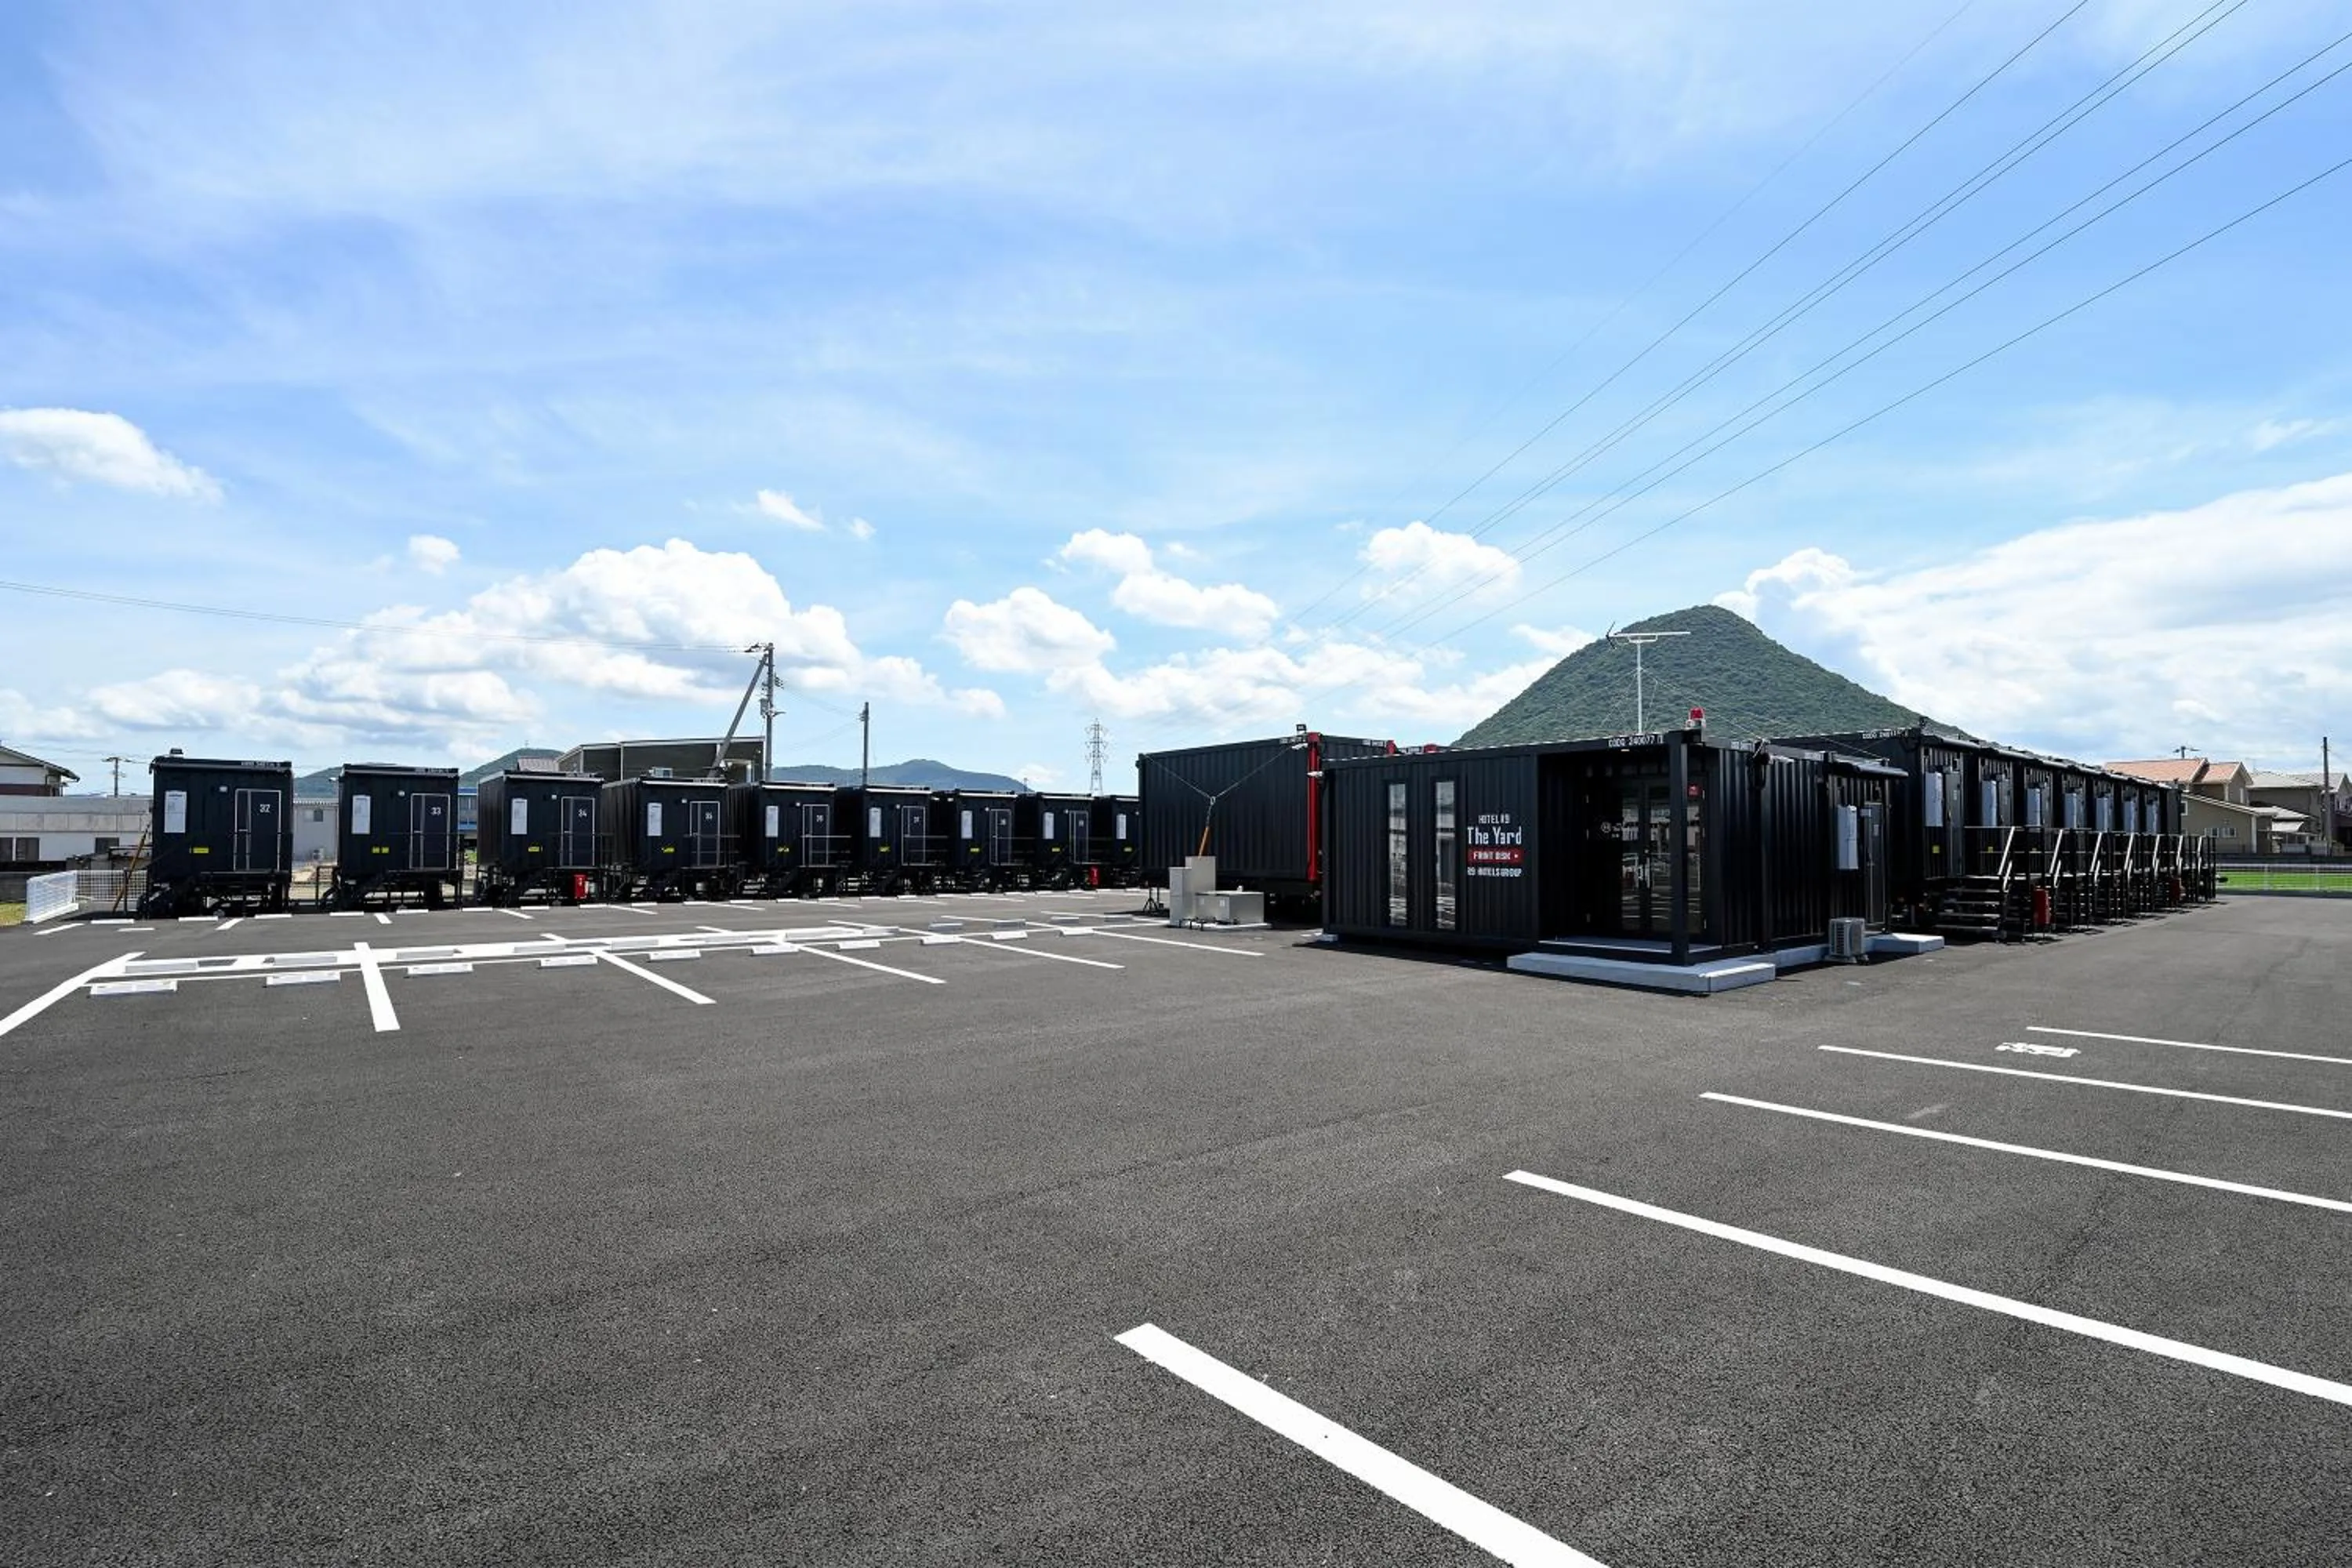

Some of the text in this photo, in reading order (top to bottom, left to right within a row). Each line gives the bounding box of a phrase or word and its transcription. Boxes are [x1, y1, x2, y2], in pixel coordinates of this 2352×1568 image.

[260, 804, 270, 813] 32
[1478, 815, 1500, 824] HOTEL
[1467, 826, 1523, 845] The Yard
